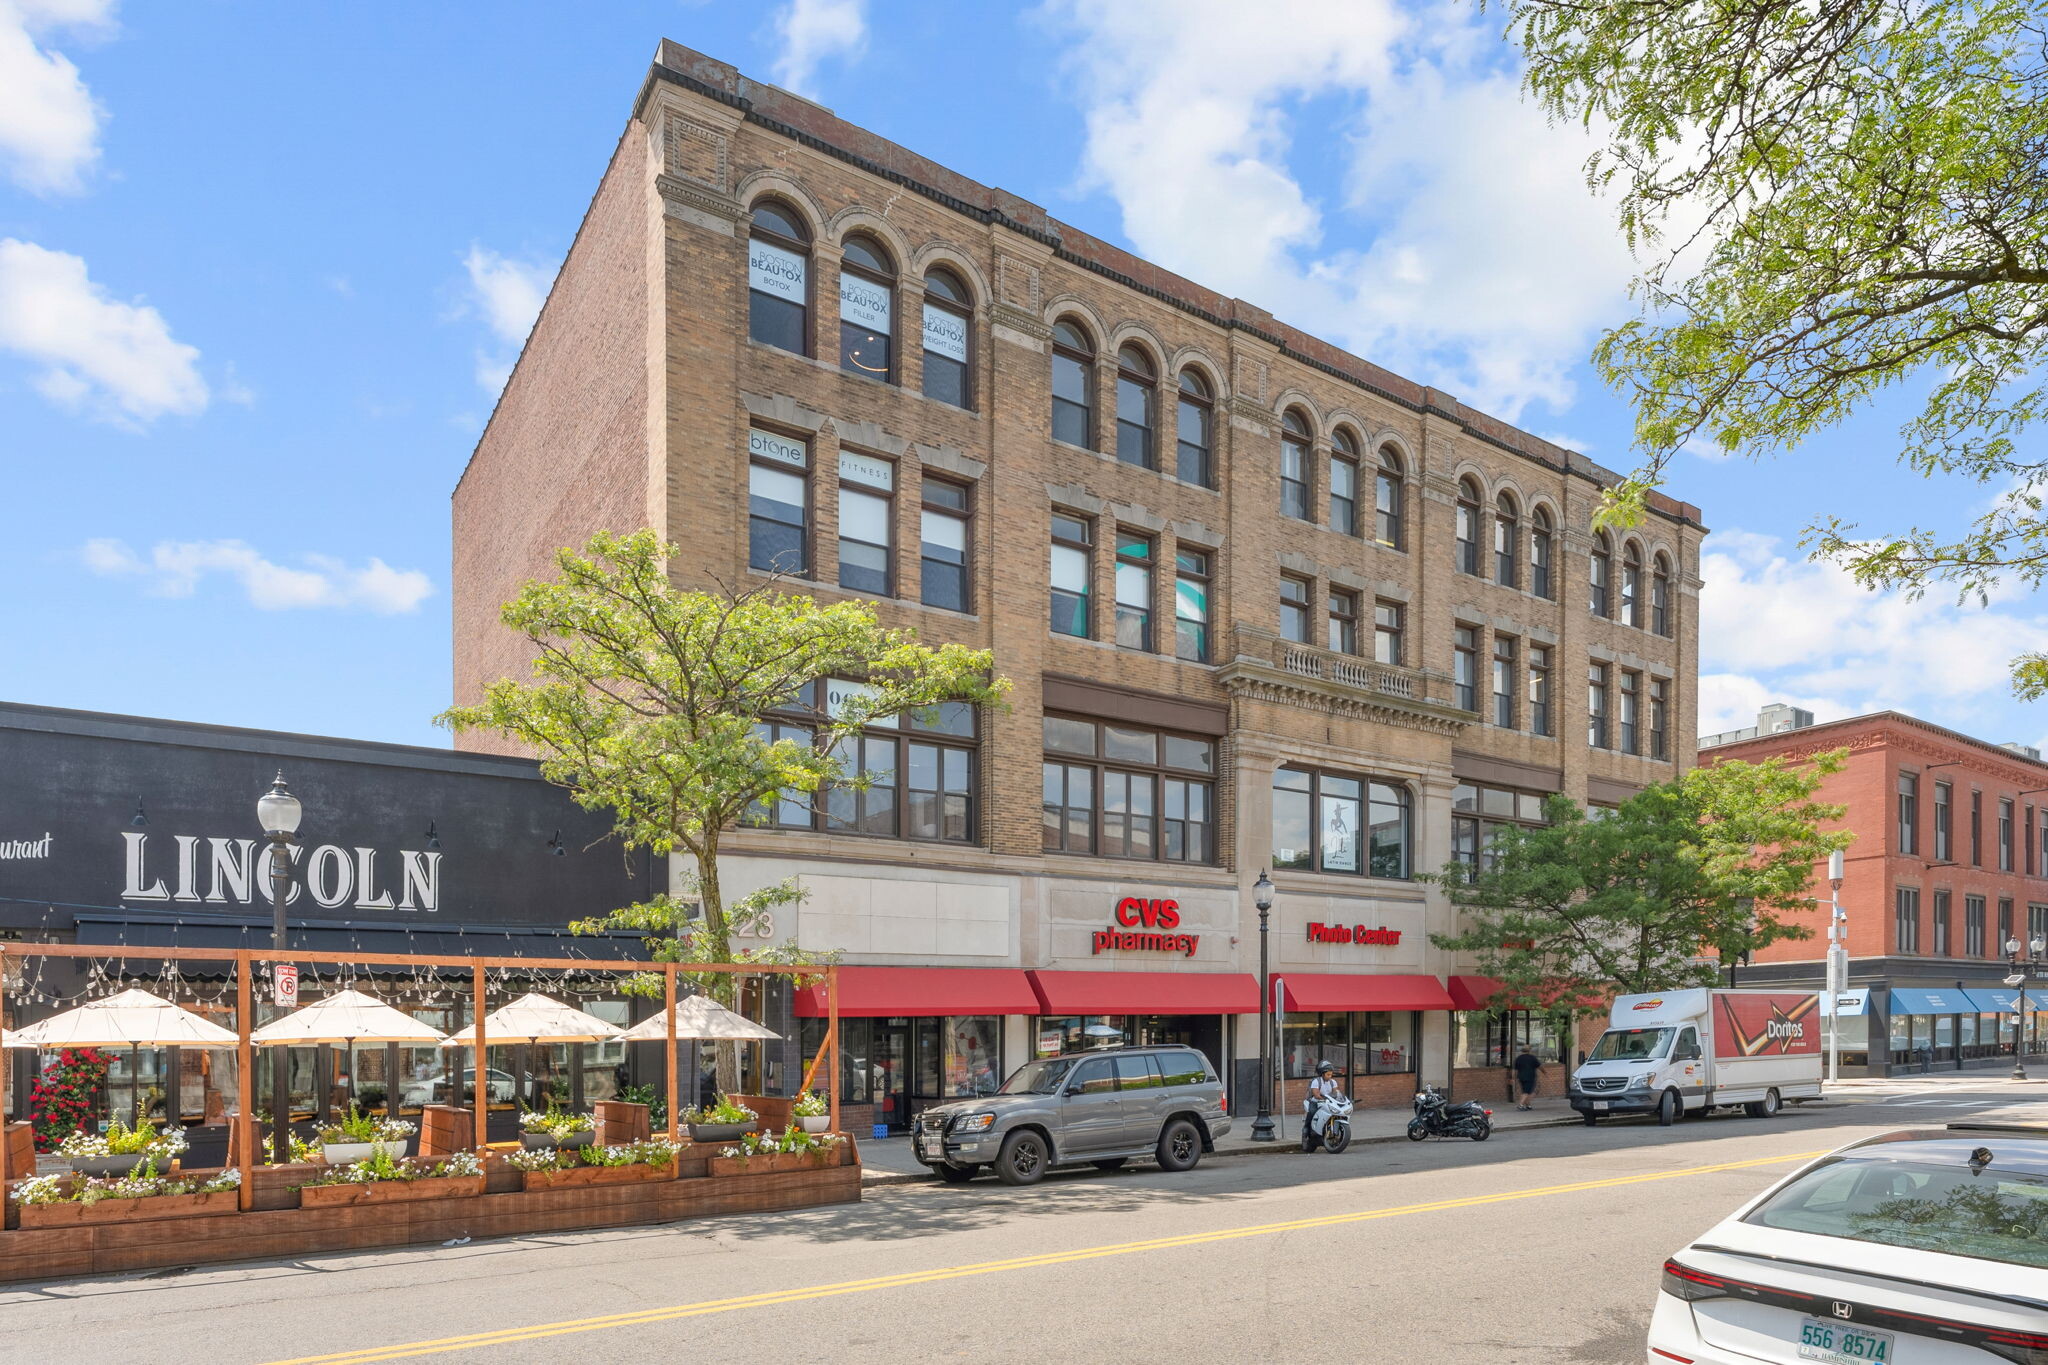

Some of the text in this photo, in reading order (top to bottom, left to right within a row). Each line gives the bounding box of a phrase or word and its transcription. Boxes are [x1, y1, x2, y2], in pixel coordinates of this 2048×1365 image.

[751, 258, 801, 284] BEAUTOX
[760, 251, 802, 276] BOSTON
[763, 276, 791, 292] BOTOX
[848, 283, 888, 307] BOSTON
[841, 290, 887, 315] BEAUTOX
[853, 308, 875, 322] FILLER
[923, 320, 964, 344] BEAUTOX
[928, 313, 964, 338] BOSTON
[948, 343, 964, 355] LOSS
[841, 460, 888, 480] FITNESS
[0, 831, 54, 860] urant
[120, 831, 443, 913] LINCOLN
[727, 911, 775, 939] 23
[1115, 896, 1181, 929] CVS
[1092, 926, 1200, 957] pharmacy
[1307, 921, 1402, 945] Photo Center
[1767, 1020, 1803, 1038] Doritos
[1802, 1325, 1886, 1361] 556 8574
